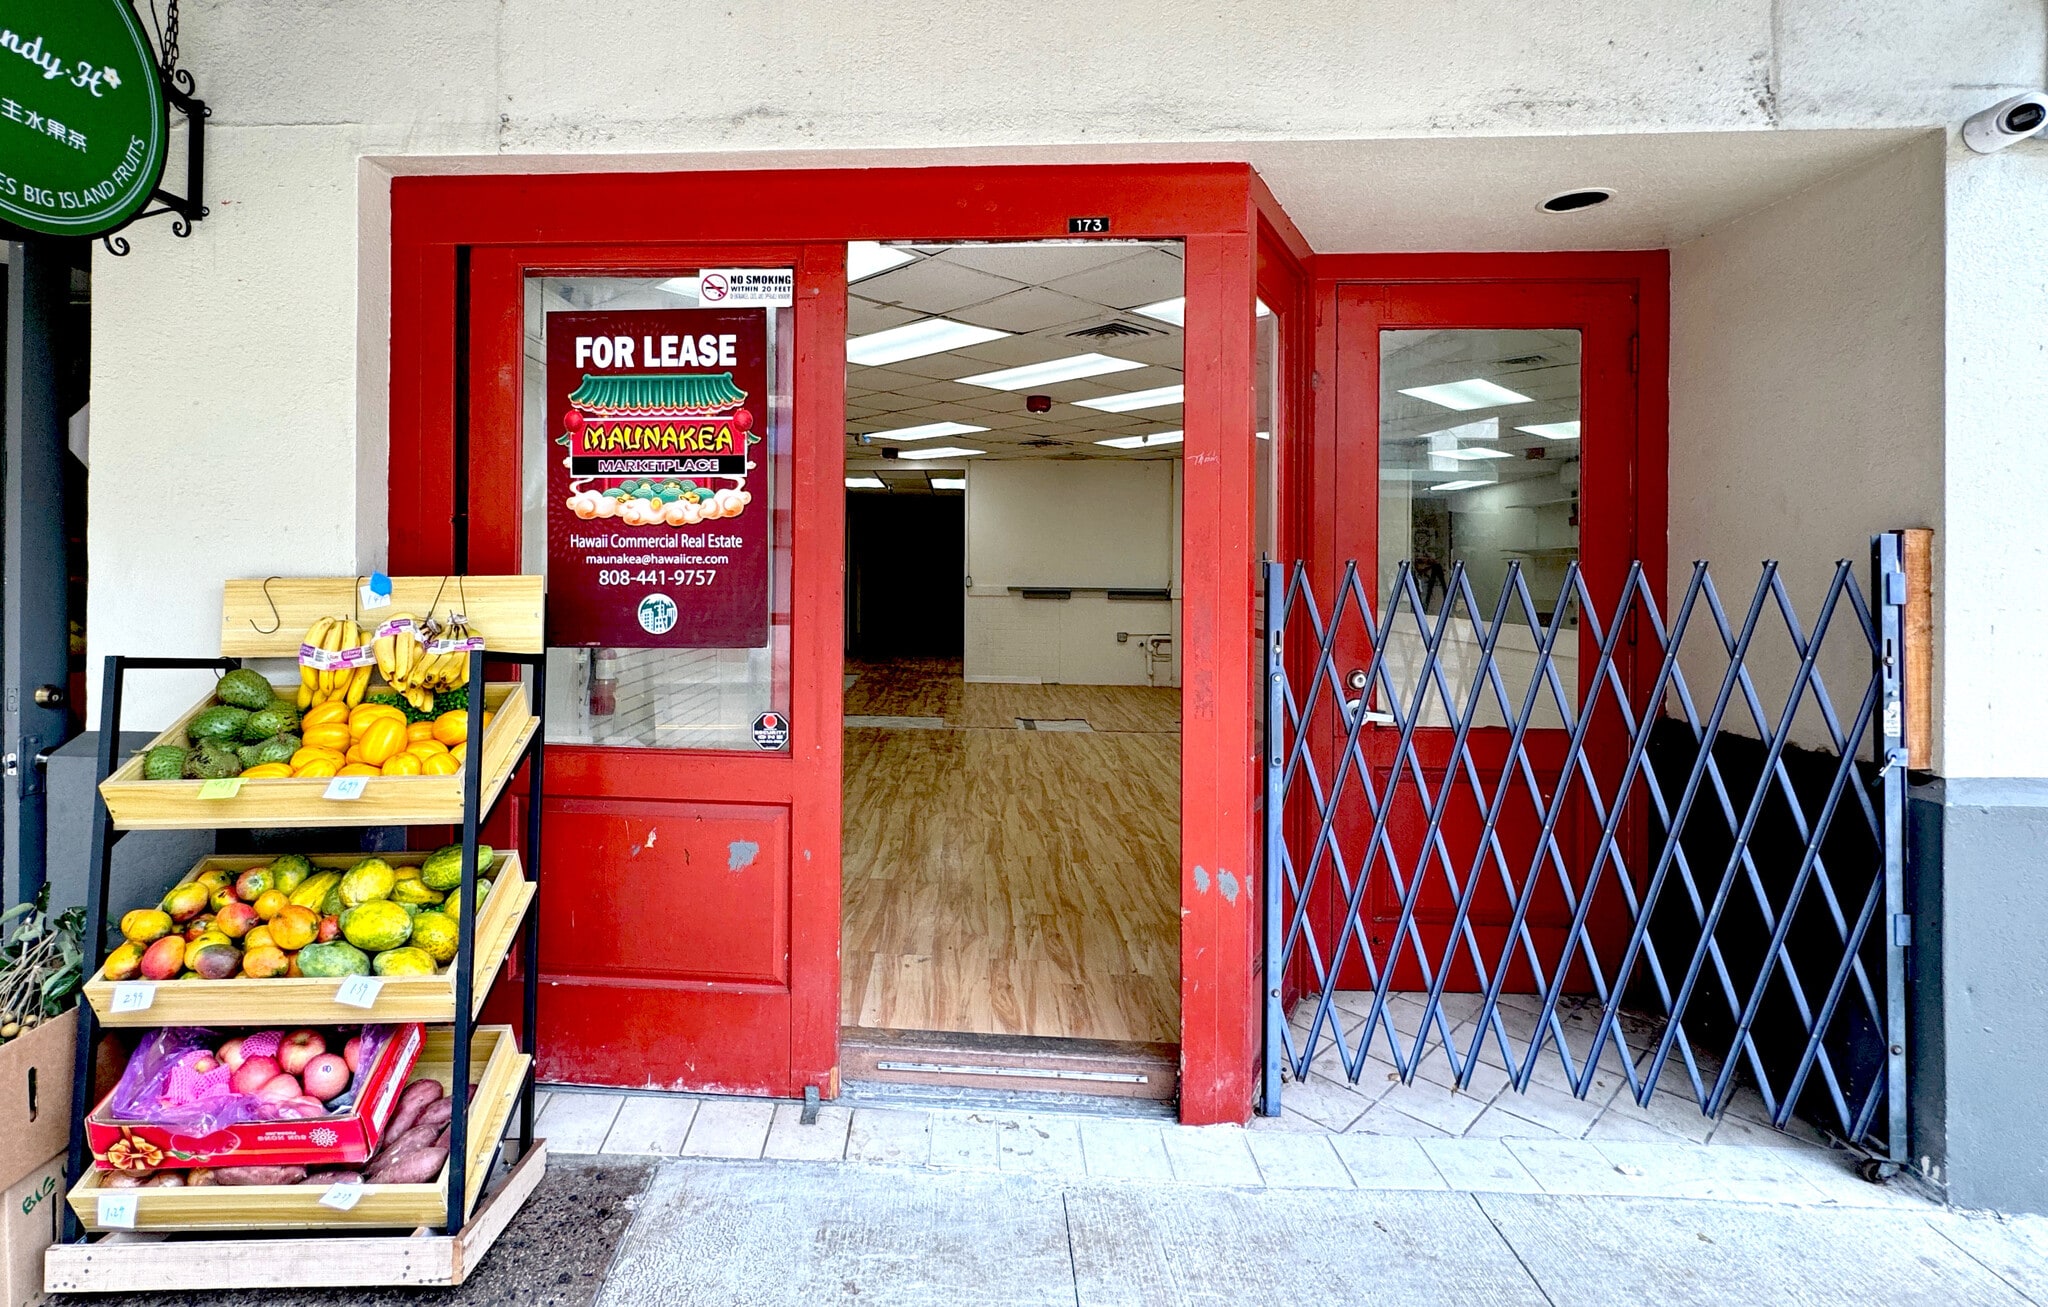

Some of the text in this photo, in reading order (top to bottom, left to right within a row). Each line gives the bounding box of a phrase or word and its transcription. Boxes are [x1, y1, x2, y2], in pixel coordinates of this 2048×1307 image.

[23, 183, 55, 208] BIG
[58, 180, 116, 209] ISLAND
[112, 134, 146, 188] FRUITS
[1076, 219, 1102, 232] 173
[730, 275, 791, 284] NO SMOKING
[575, 334, 737, 368] FOR LEASE
[583, 423, 734, 453] MAUNAKEA
[598, 459, 719, 472] MARKETPLACE
[570, 534, 743, 548] Hawaii Commercial Real Estate
[585, 553, 729, 565] maunakea@hawaiicre.com
[598, 569, 716, 586] 808-441-9757
[22, 1176, 56, 1215] BIG
